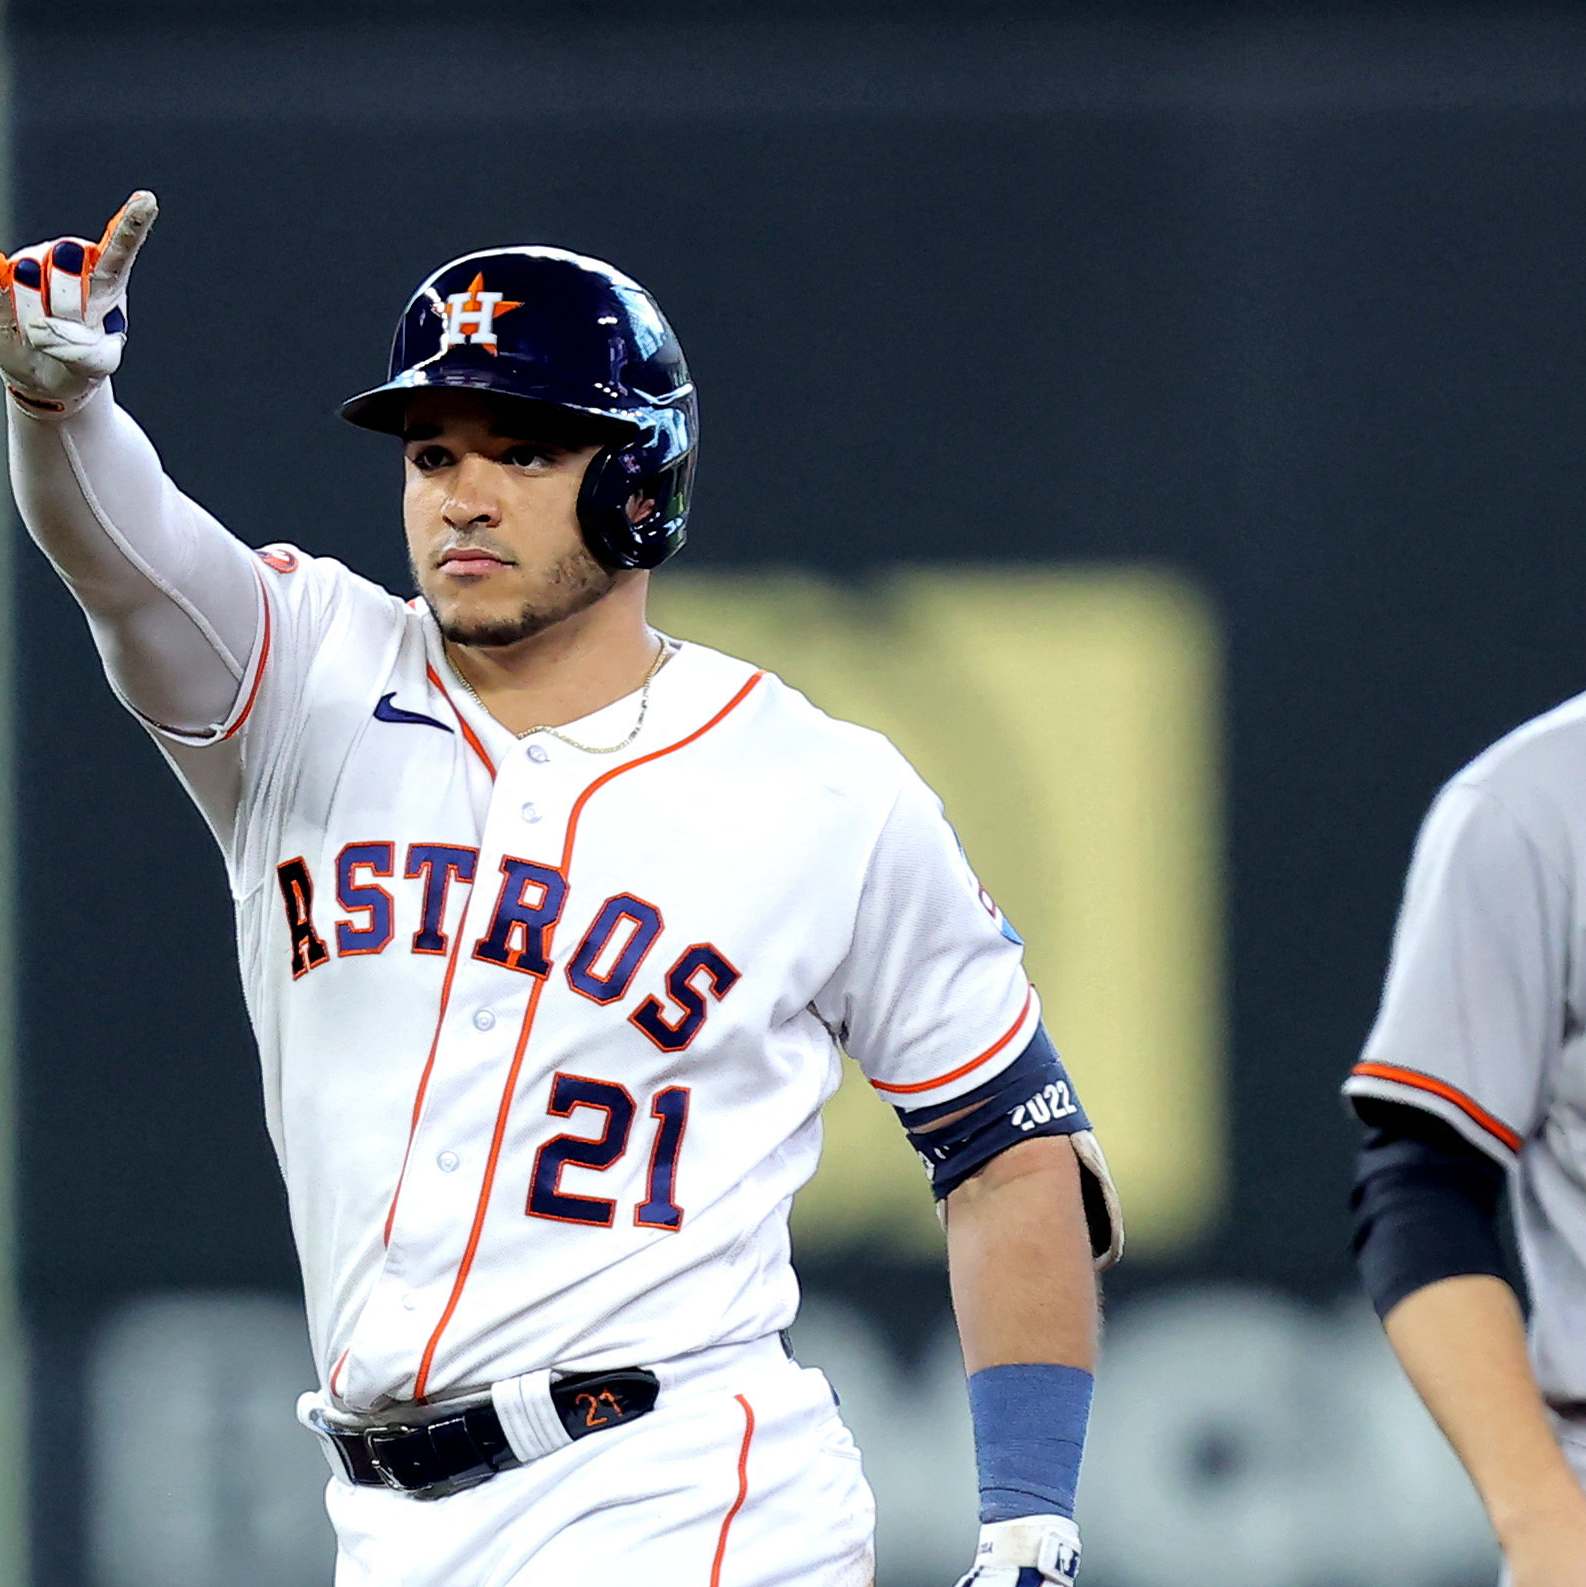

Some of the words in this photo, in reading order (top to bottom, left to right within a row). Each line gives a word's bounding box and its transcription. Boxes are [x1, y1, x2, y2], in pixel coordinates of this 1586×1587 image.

[447, 292, 503, 346] H
[276, 840, 741, 1053] ASTROS
[1006, 1080, 1077, 1131] 2022
[525, 1072, 692, 1231] 21
[575, 1387, 624, 1426] 21
